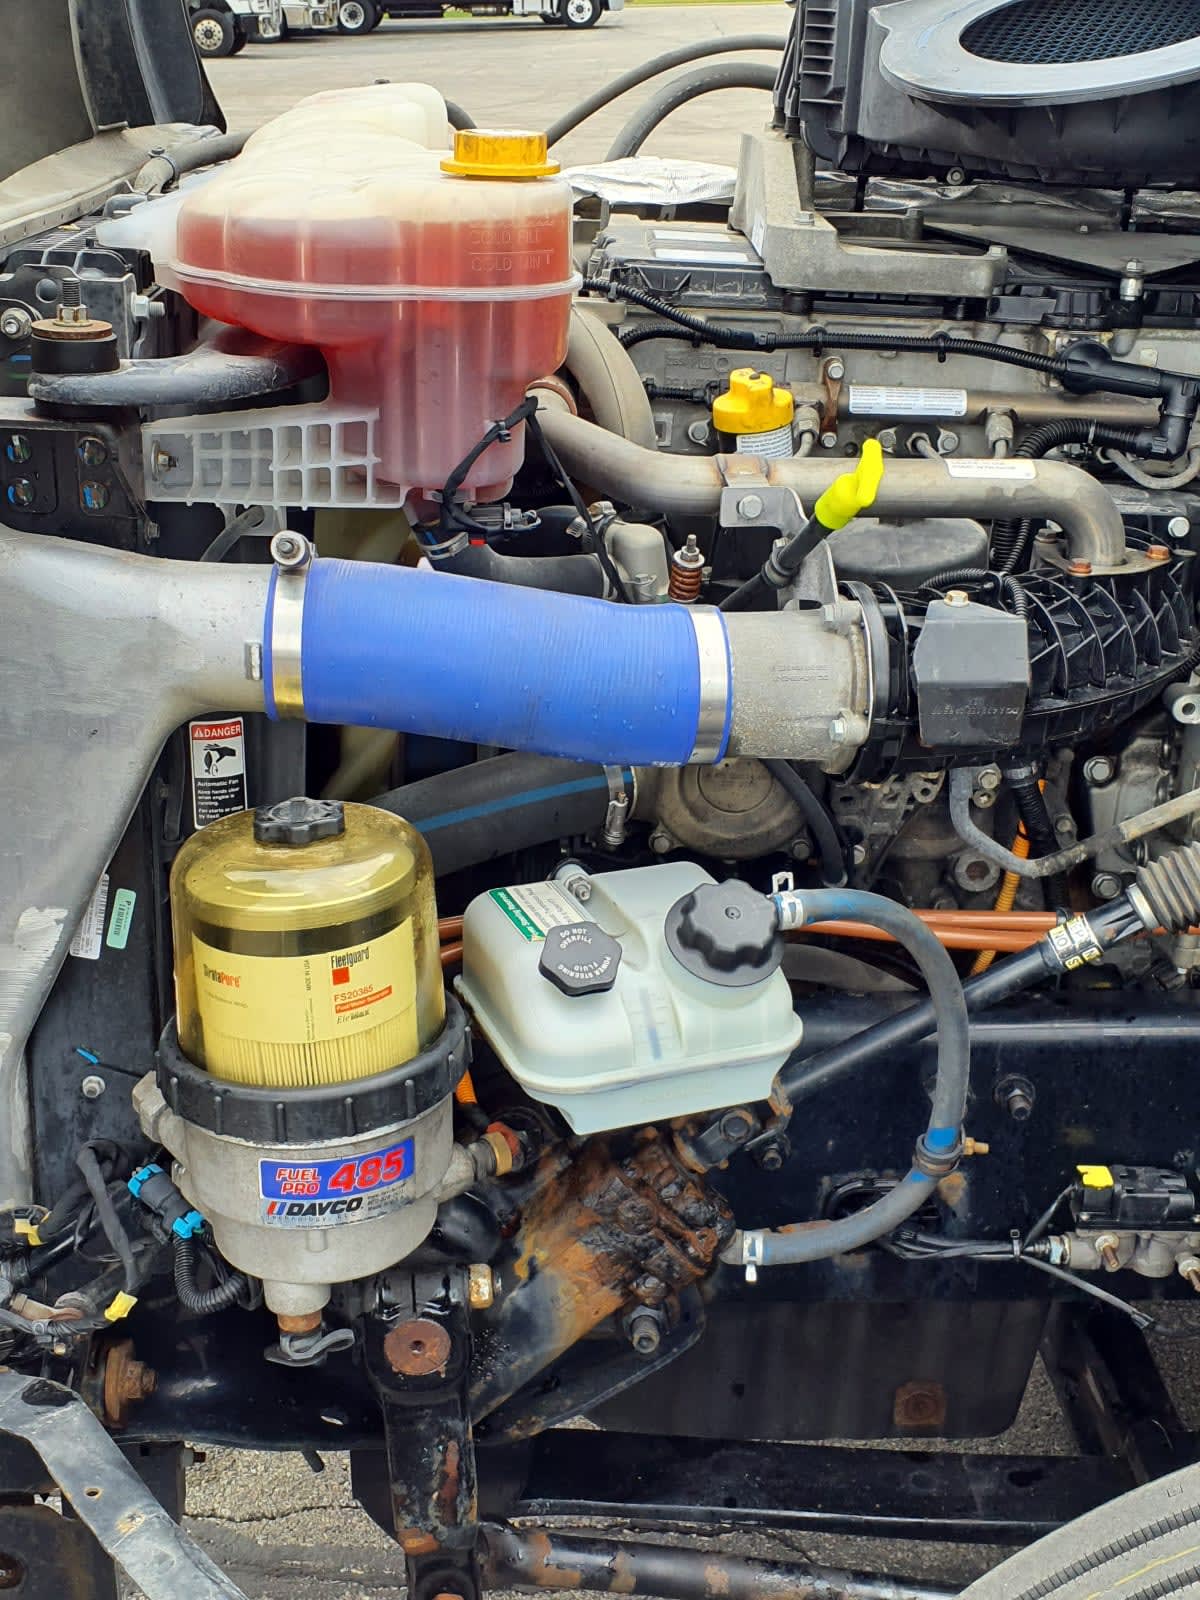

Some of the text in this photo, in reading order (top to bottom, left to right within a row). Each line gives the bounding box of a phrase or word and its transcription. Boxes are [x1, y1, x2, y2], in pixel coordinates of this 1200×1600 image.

[471, 256, 513, 272] COLD
[204, 724, 241, 737] DANGER
[560, 930, 570, 938] DO
[560, 935, 592, 949] OVERFILL
[330, 946, 370, 969] Fleetguard
[558, 956, 611, 979] POWER STEERING
[573, 961, 599, 972] FLUID
[276, 1167, 322, 1182] FUEL
[327, 1147, 405, 1193] 485
[281, 1182, 320, 1195] PRO
[285, 1196, 363, 1217] DAVCO
